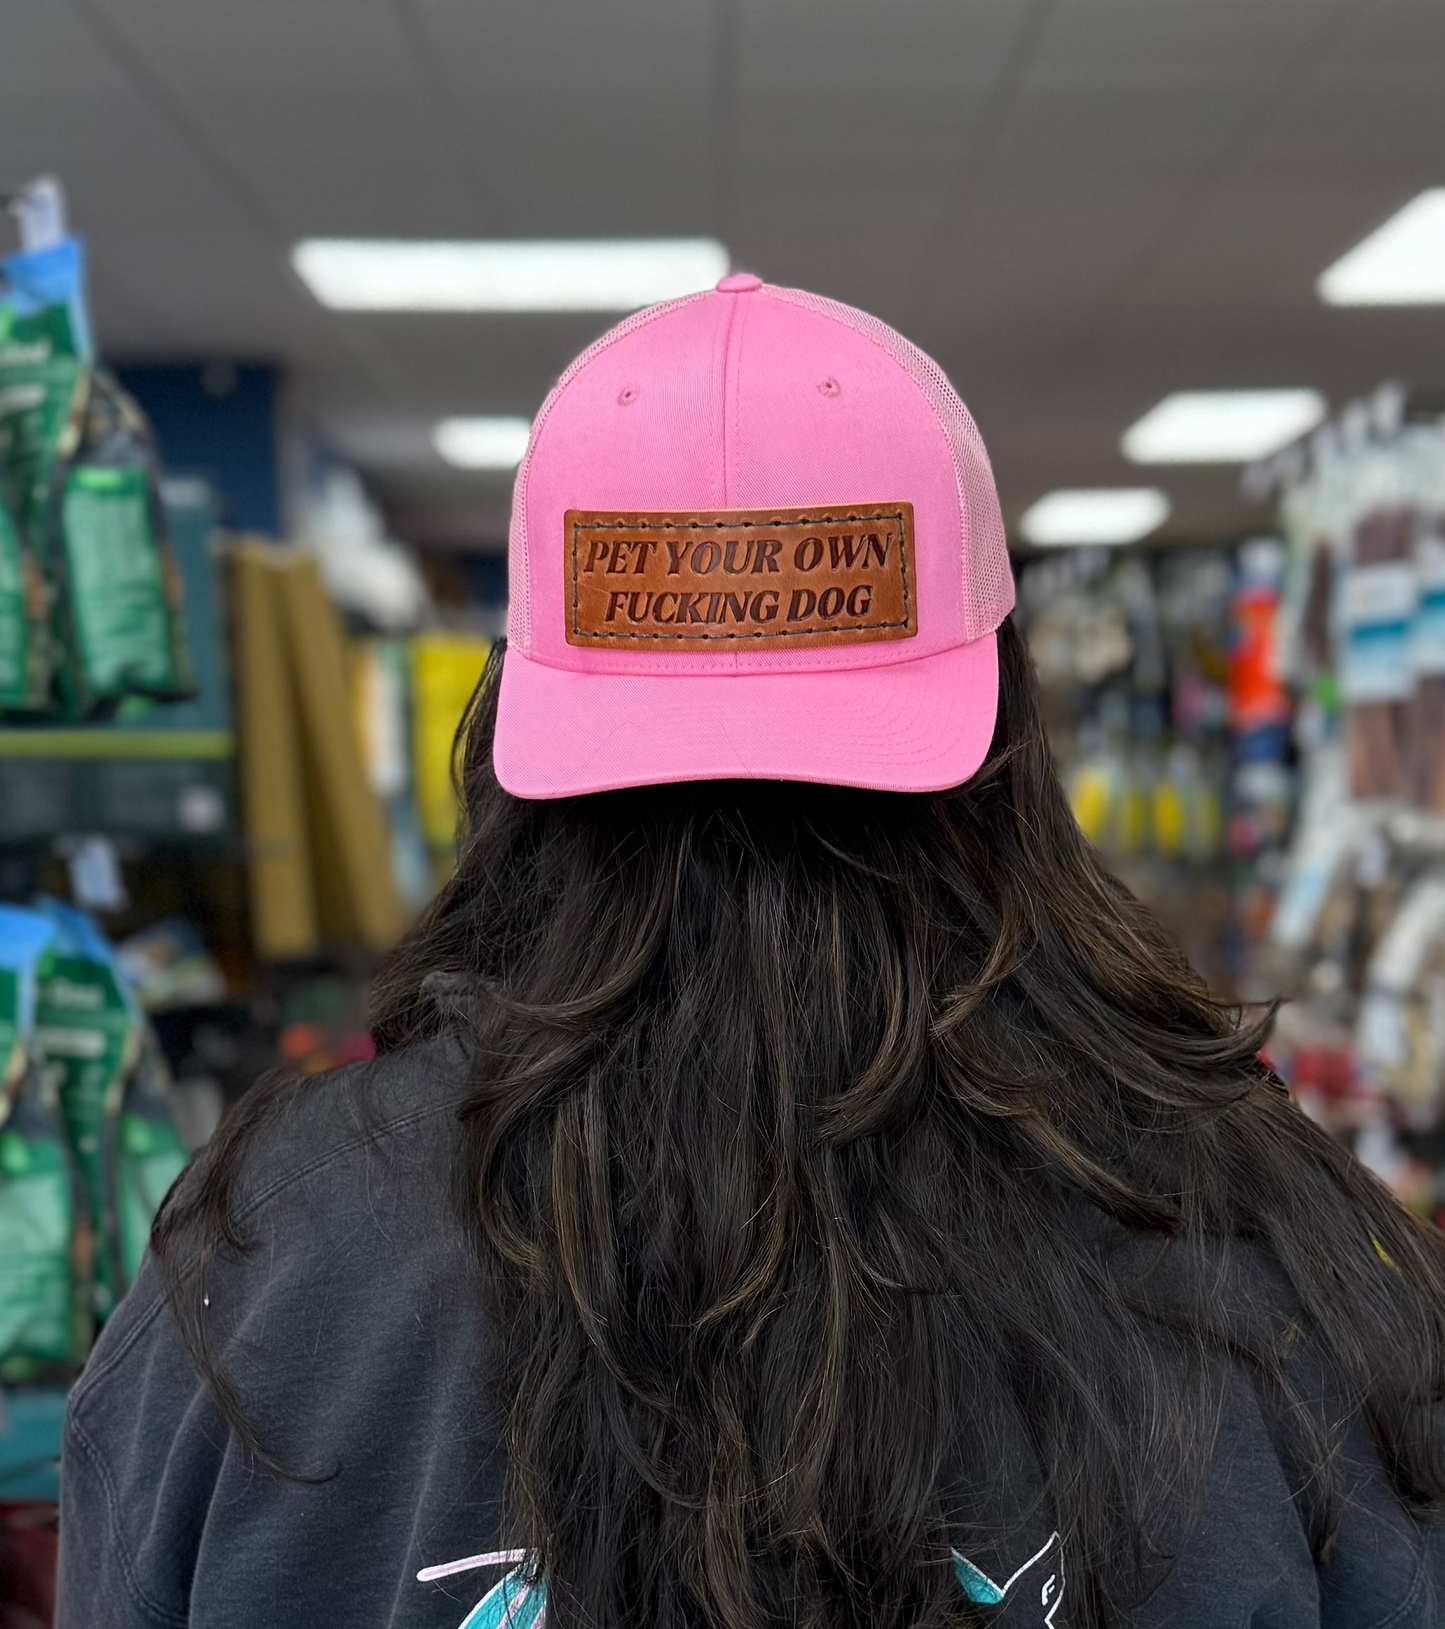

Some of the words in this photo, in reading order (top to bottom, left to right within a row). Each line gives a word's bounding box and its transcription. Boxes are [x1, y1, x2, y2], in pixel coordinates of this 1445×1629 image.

[583, 541, 657, 574] PET
[665, 540, 783, 575] YOUR
[794, 532, 893, 572] OWN
[604, 590, 779, 624] FUCKING
[786, 585, 873, 623] DOG
